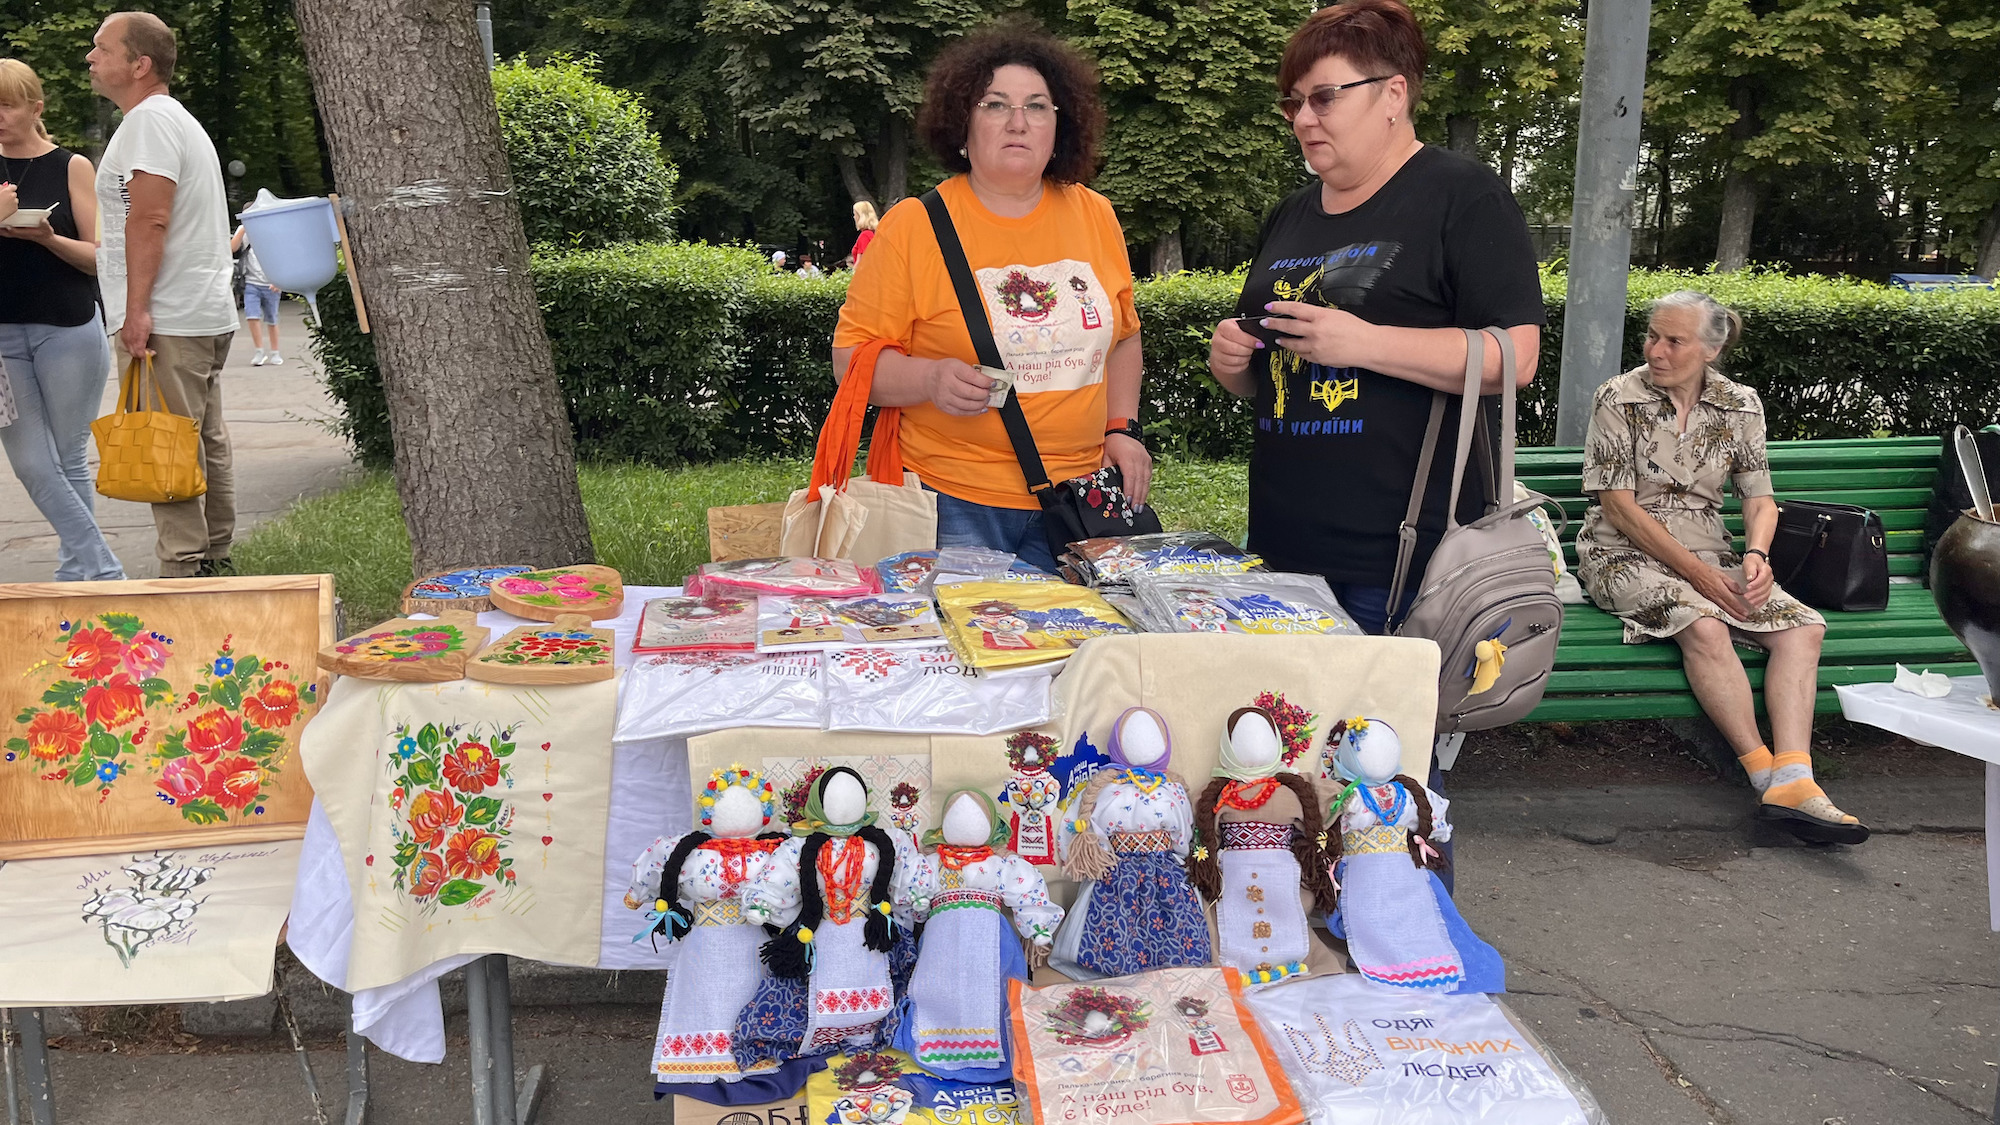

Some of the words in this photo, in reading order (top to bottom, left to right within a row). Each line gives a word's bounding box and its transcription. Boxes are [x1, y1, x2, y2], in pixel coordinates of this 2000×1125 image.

[1268, 256, 1325, 271] ДОБРОГО
[1005, 361, 1014, 370] А
[1018, 362, 1042, 371] наш
[1045, 359, 1061, 371] рід
[1023, 371, 1052, 384] буде!
[1291, 417, 1363, 436] УКРАЇНИ
[1043, 620, 1059, 628] А
[1067, 769, 1075, 788] А
[1371, 1018, 1436, 1032] ОДЯГ
[1385, 1036, 1522, 1056] ВІЛЬНИХ
[1402, 1062, 1498, 1081] ЛЮДЕЙ
[932, 1090, 956, 1105] А
[952, 1086, 992, 1098] наш
[1061, 1094, 1076, 1104] А
[1083, 1091, 1126, 1102] наш
[1134, 1086, 1167, 1101] рід
[960, 1094, 996, 1110] рід
[1082, 1104, 1089, 1118] і
[1095, 1100, 1151, 1118] буде!
[934, 1105, 962, 1125] Є
